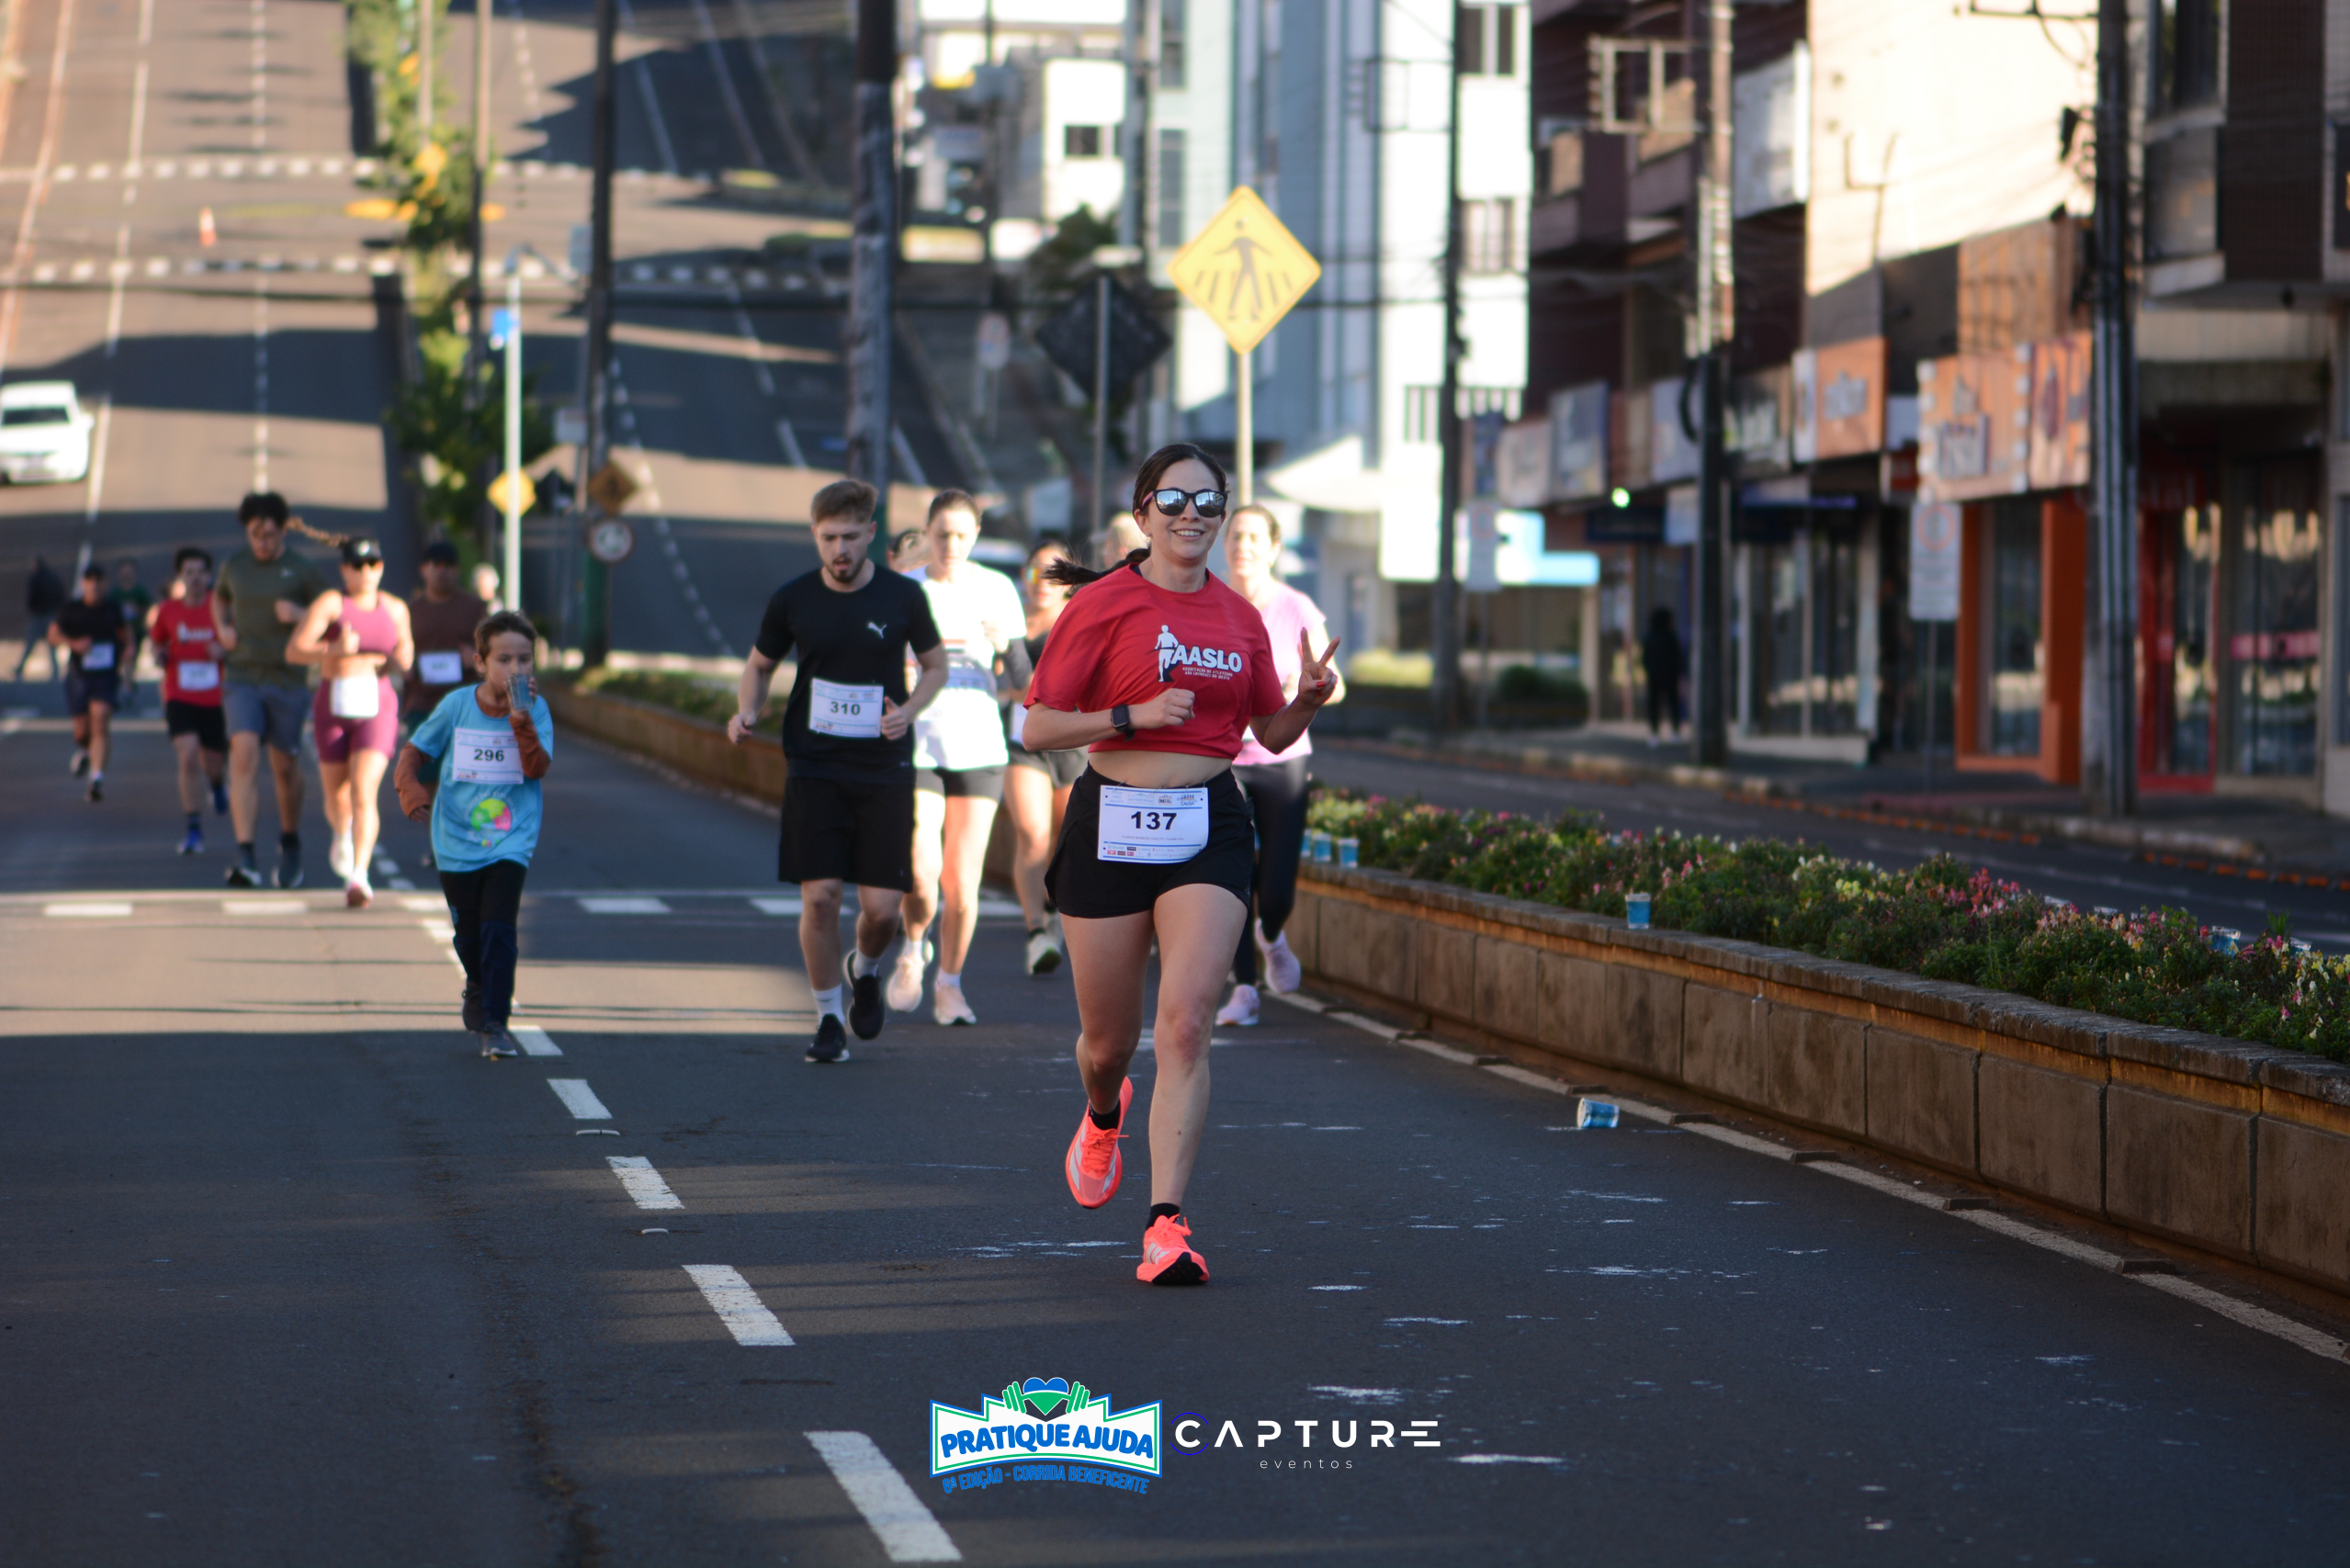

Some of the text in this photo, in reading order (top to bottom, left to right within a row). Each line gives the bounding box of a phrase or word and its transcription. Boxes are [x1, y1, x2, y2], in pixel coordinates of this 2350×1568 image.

[1170, 644, 1243, 673] AASLO
[830, 701, 861, 716] 310
[473, 749, 505, 762] 296
[1130, 811, 1177, 830] 137
